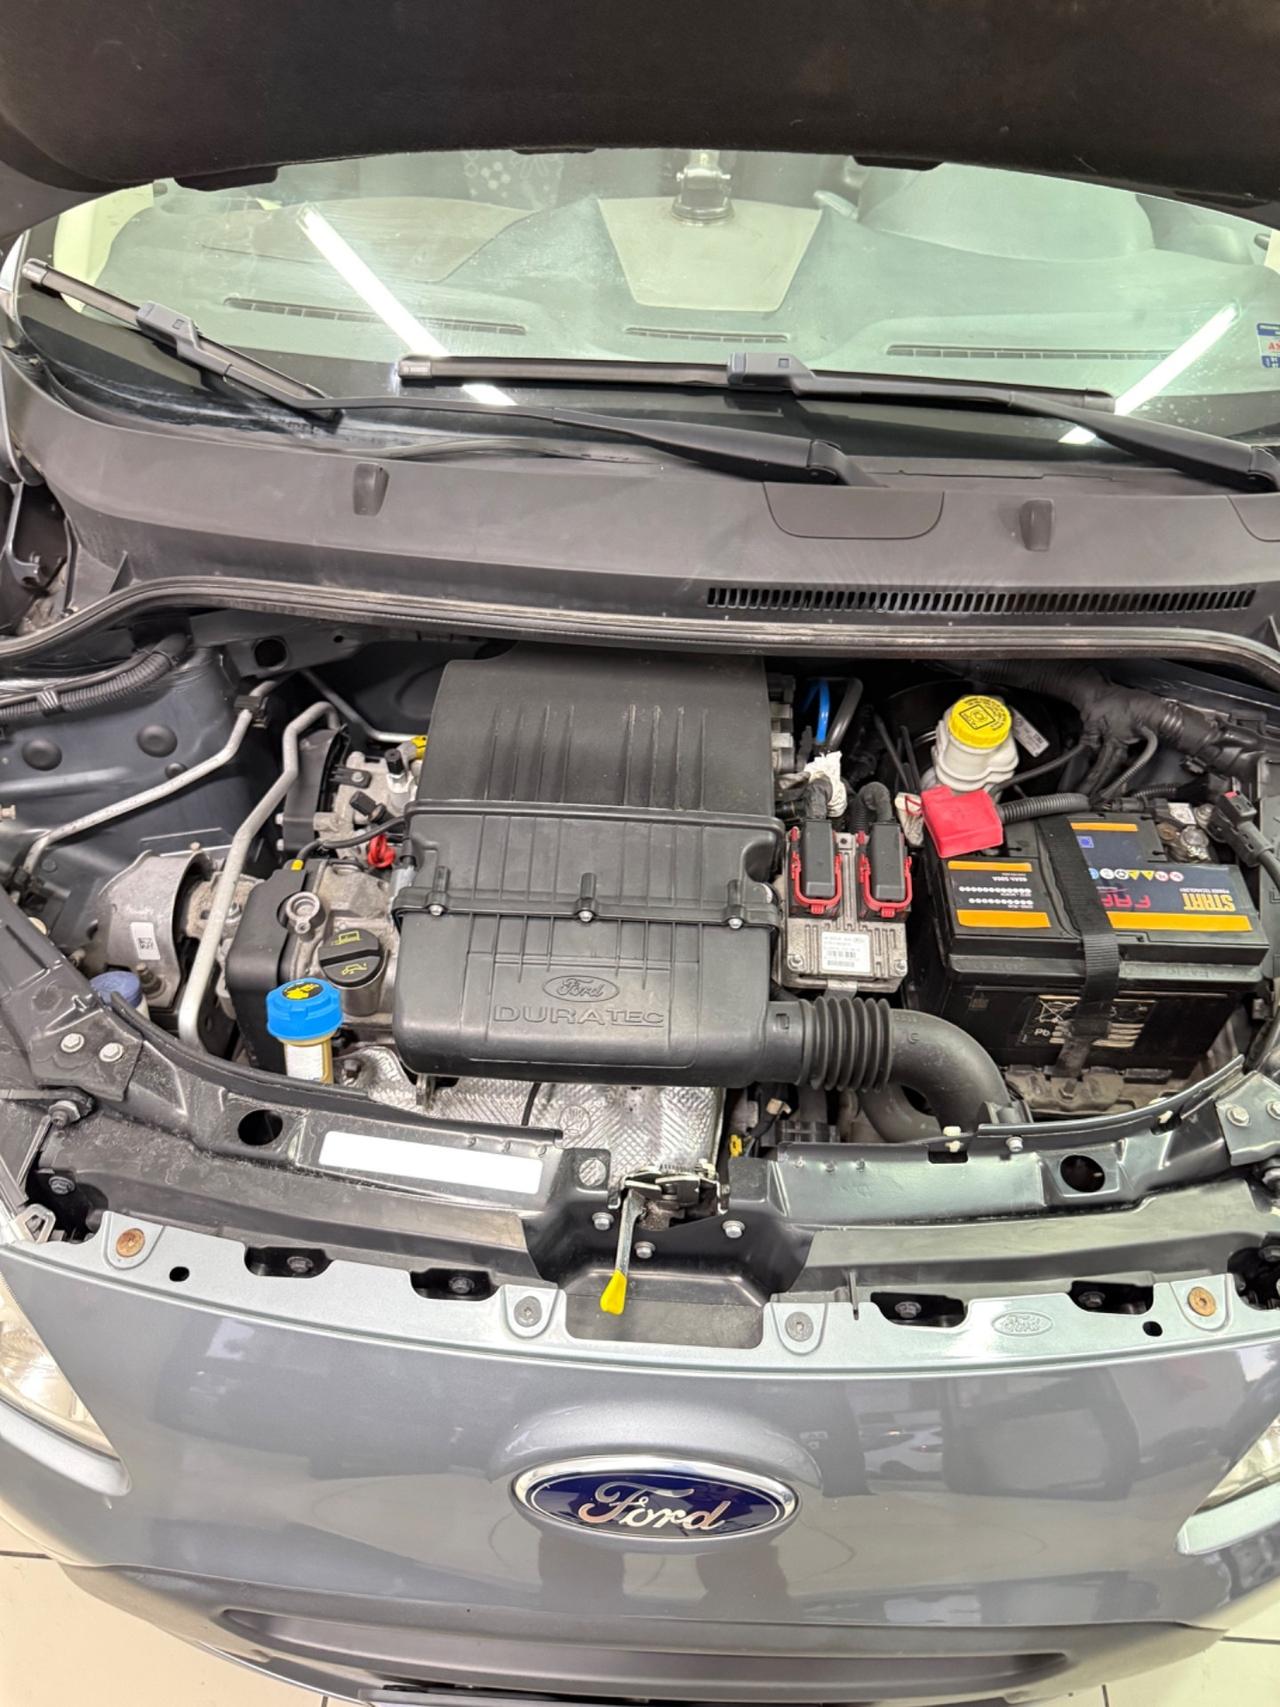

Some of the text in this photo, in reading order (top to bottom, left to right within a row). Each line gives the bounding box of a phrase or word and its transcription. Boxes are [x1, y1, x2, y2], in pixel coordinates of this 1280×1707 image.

[1182, 893, 1236, 912] START
[556, 978, 604, 998] Ford
[493, 1005, 664, 1026] DURATEC
[577, 1480, 732, 1531] Ford
